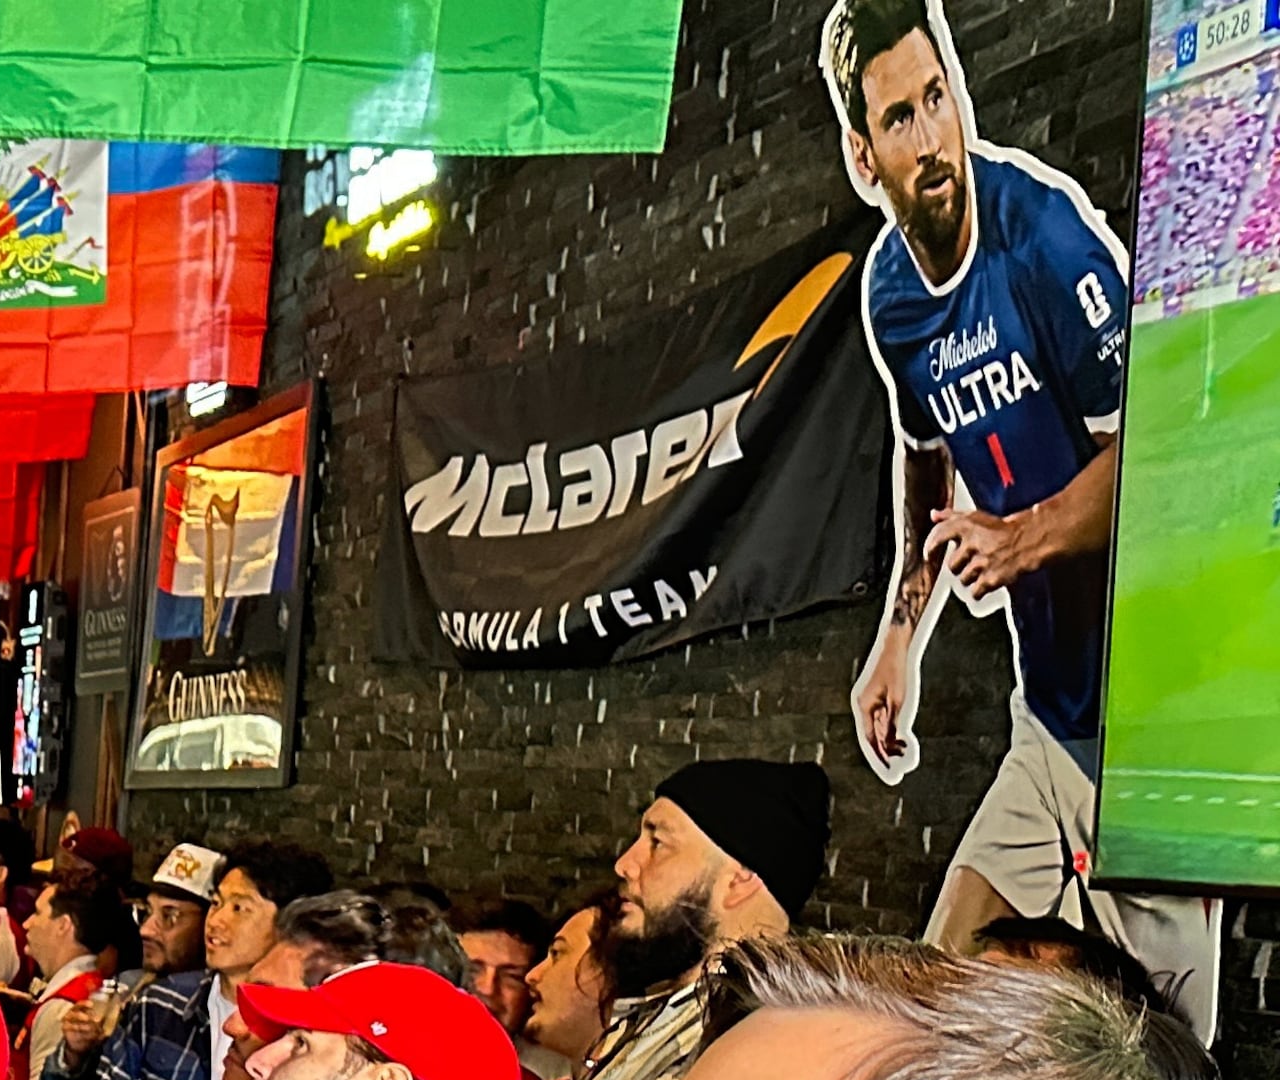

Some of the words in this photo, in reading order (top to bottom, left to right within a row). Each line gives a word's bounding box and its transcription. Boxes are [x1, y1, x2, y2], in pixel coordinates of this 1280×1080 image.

[1206, 9, 1250, 50] 50:28
[928, 315, 998, 382] Michelob
[927, 351, 1041, 434] ULTRA
[167, 669, 247, 722] GUINNESS
